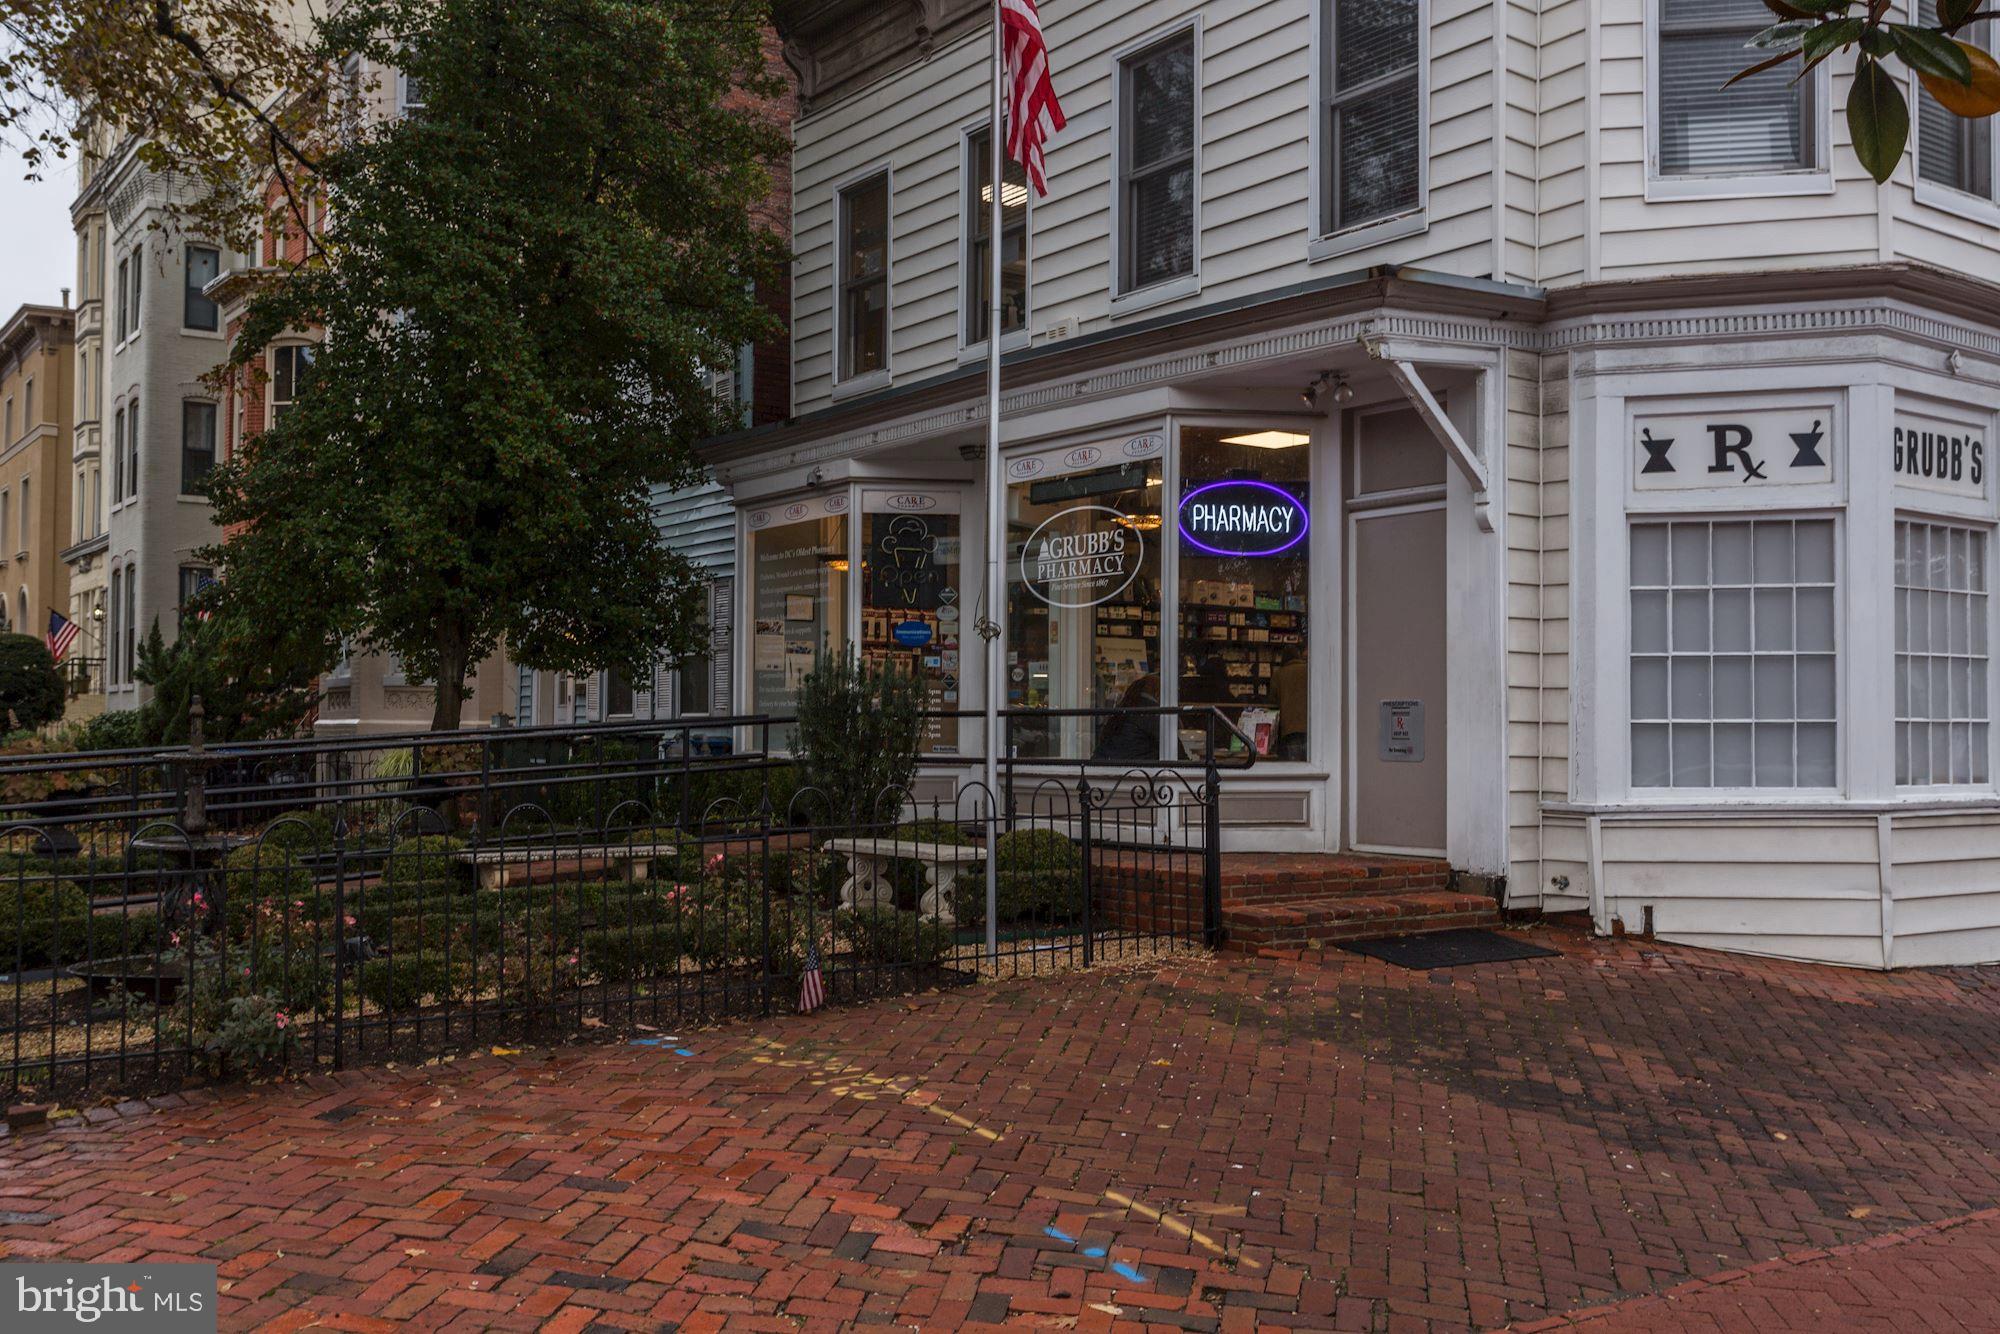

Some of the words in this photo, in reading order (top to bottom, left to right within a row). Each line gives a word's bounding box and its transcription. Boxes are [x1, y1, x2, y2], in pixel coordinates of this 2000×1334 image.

[1131, 438, 1154, 449] CARE
[1071, 449, 1093, 462] CARE
[1016, 460, 1036, 472] CARE
[897, 496, 925, 505] CARE
[1192, 504, 1294, 533] PHARMACY
[1049, 529, 1125, 559] GRUBB'S
[1038, 555, 1125, 580] PHARMACY
